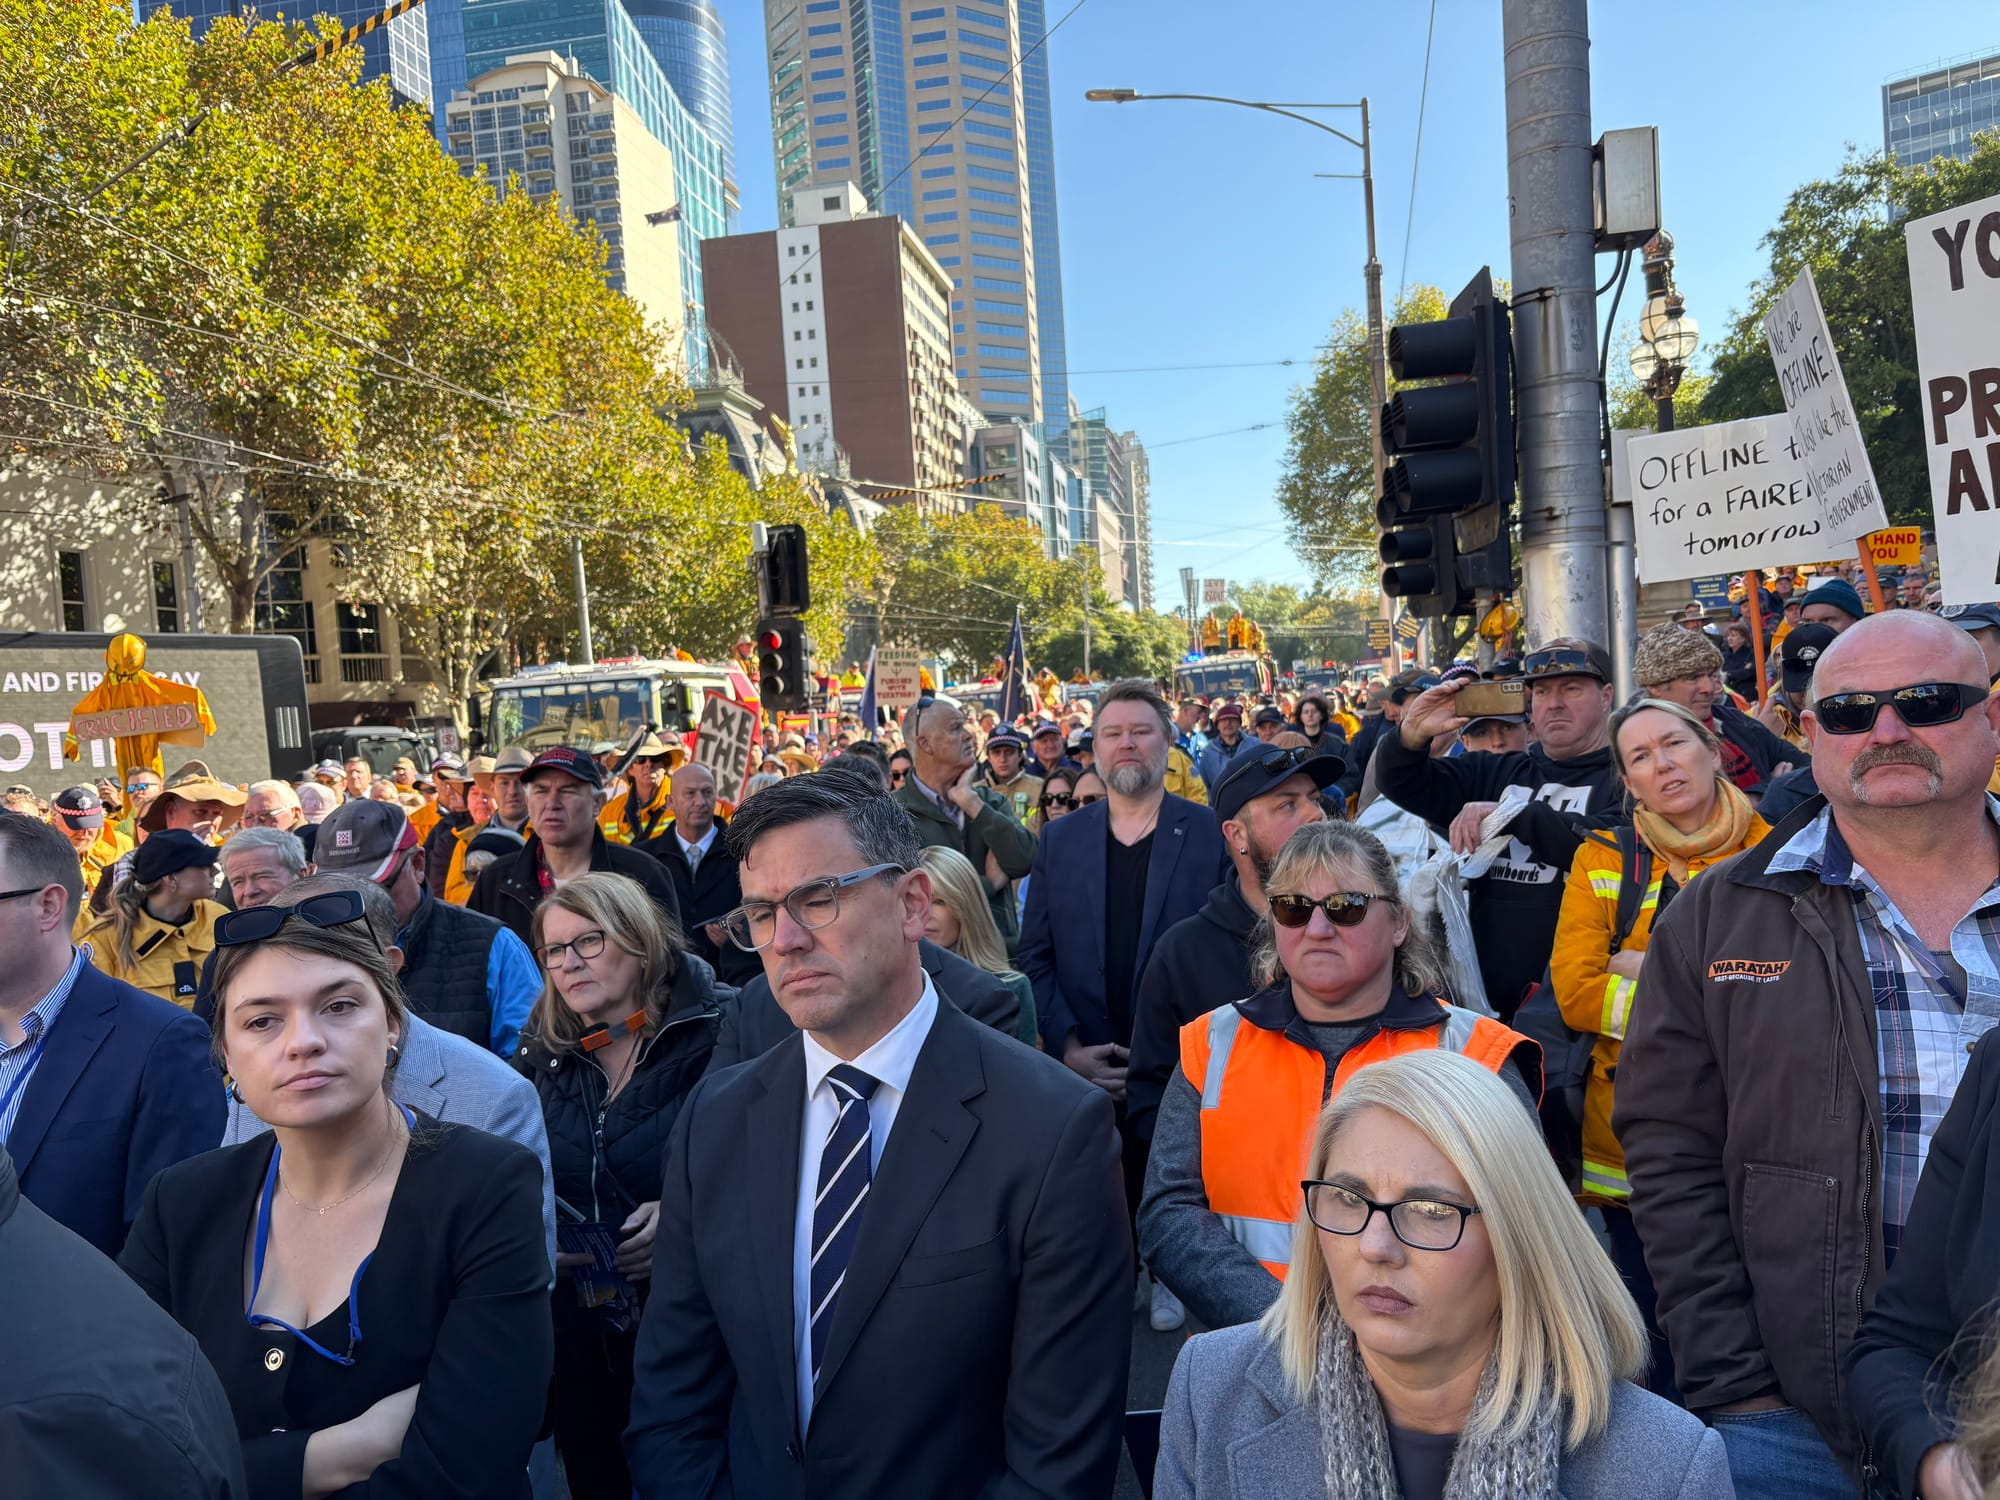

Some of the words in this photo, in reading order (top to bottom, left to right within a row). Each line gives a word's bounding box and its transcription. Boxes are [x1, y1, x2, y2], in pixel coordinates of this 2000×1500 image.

[1768, 317, 1788, 356] We
[1787, 309, 1802, 344] are
[1812, 409, 1833, 441] like
[1831, 394, 1851, 432] the
[1639, 439, 1769, 490] OFFLINE
[1649, 497, 1687, 525] for
[1696, 502, 1712, 517] a
[1726, 479, 1813, 514] FAIRE
[1683, 520, 1822, 556] tomorrow
[1873, 533, 1917, 545] HAND
[2, 671, 61, 693] AND
[75, 705, 193, 742] CRUCIFIED
[701, 696, 753, 746] AXE
[698, 732, 748, 778] THE
[1712, 961, 1784, 975] WARATAH
